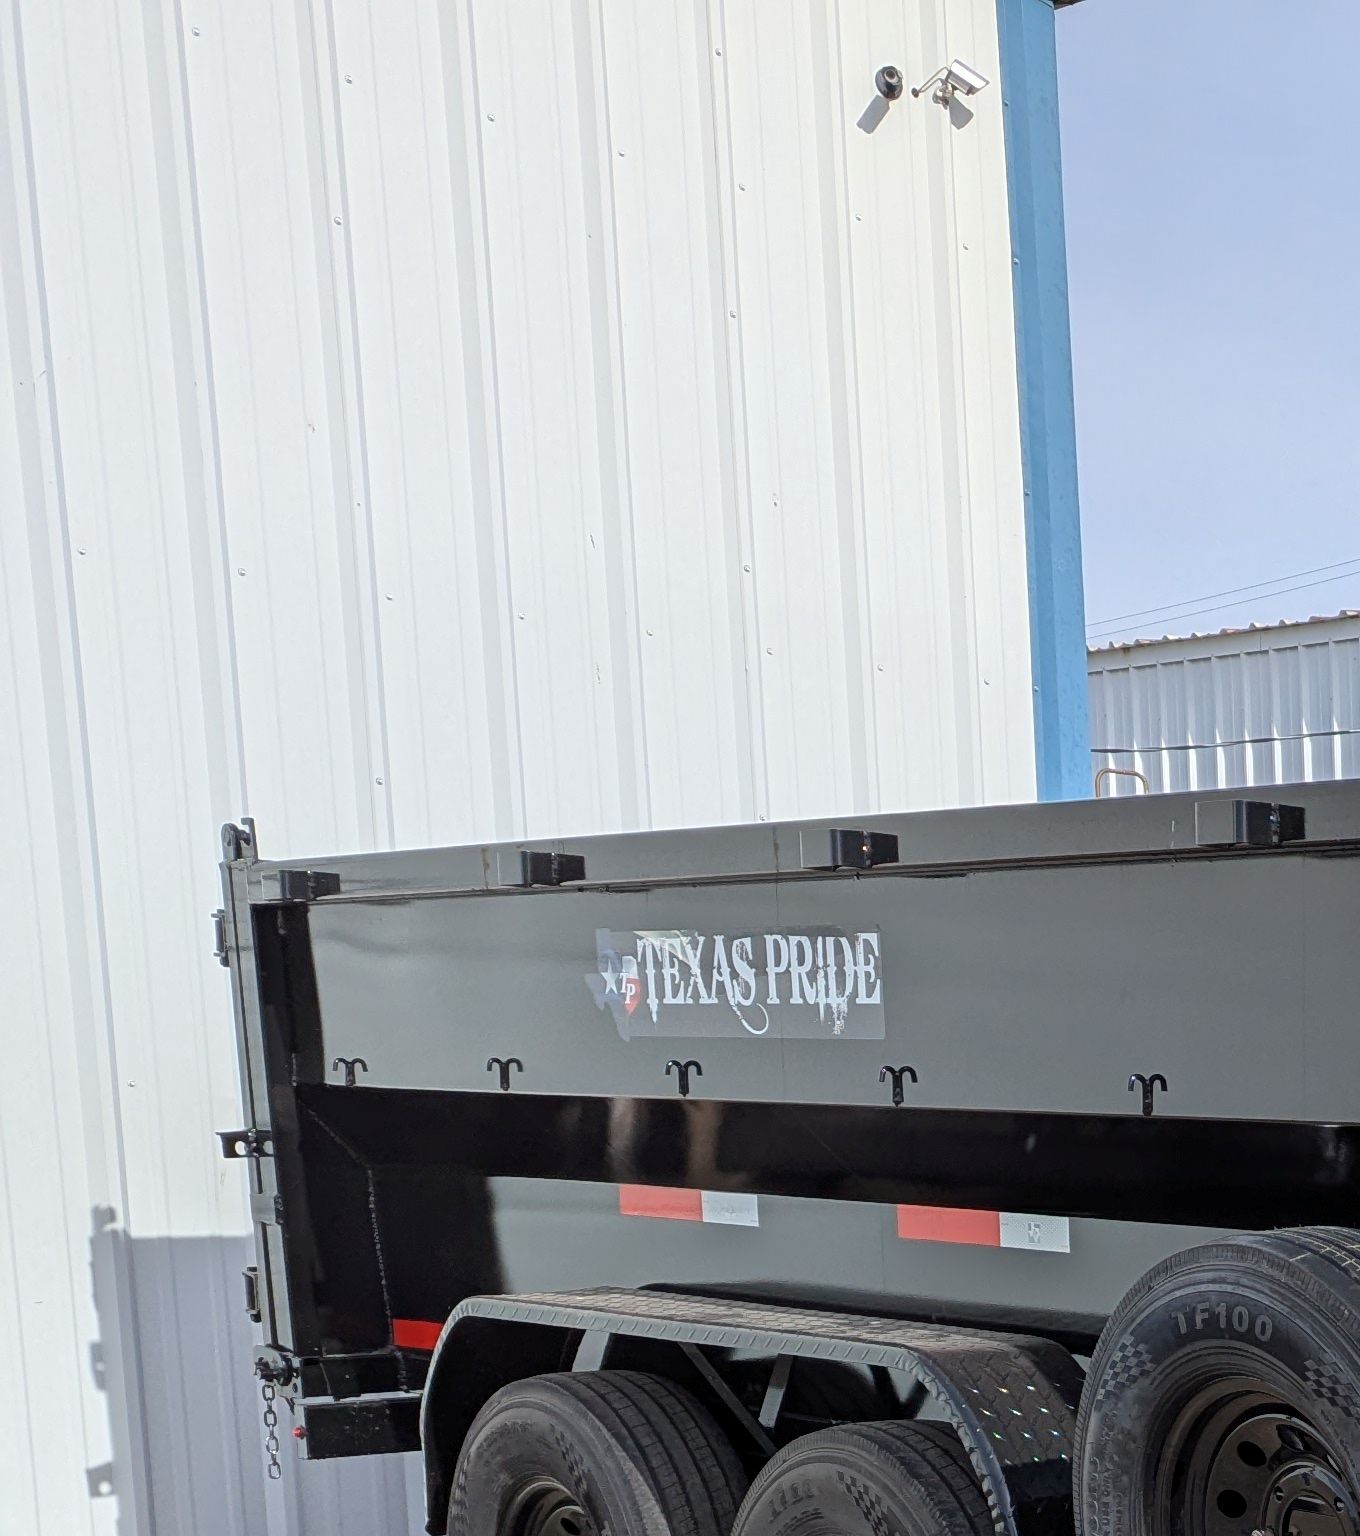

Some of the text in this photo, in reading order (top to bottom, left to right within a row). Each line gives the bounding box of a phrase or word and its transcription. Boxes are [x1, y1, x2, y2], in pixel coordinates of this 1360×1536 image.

[636, 931, 881, 1034] TEXAS PRIDE
[1169, 1301, 1273, 1343] TF100
